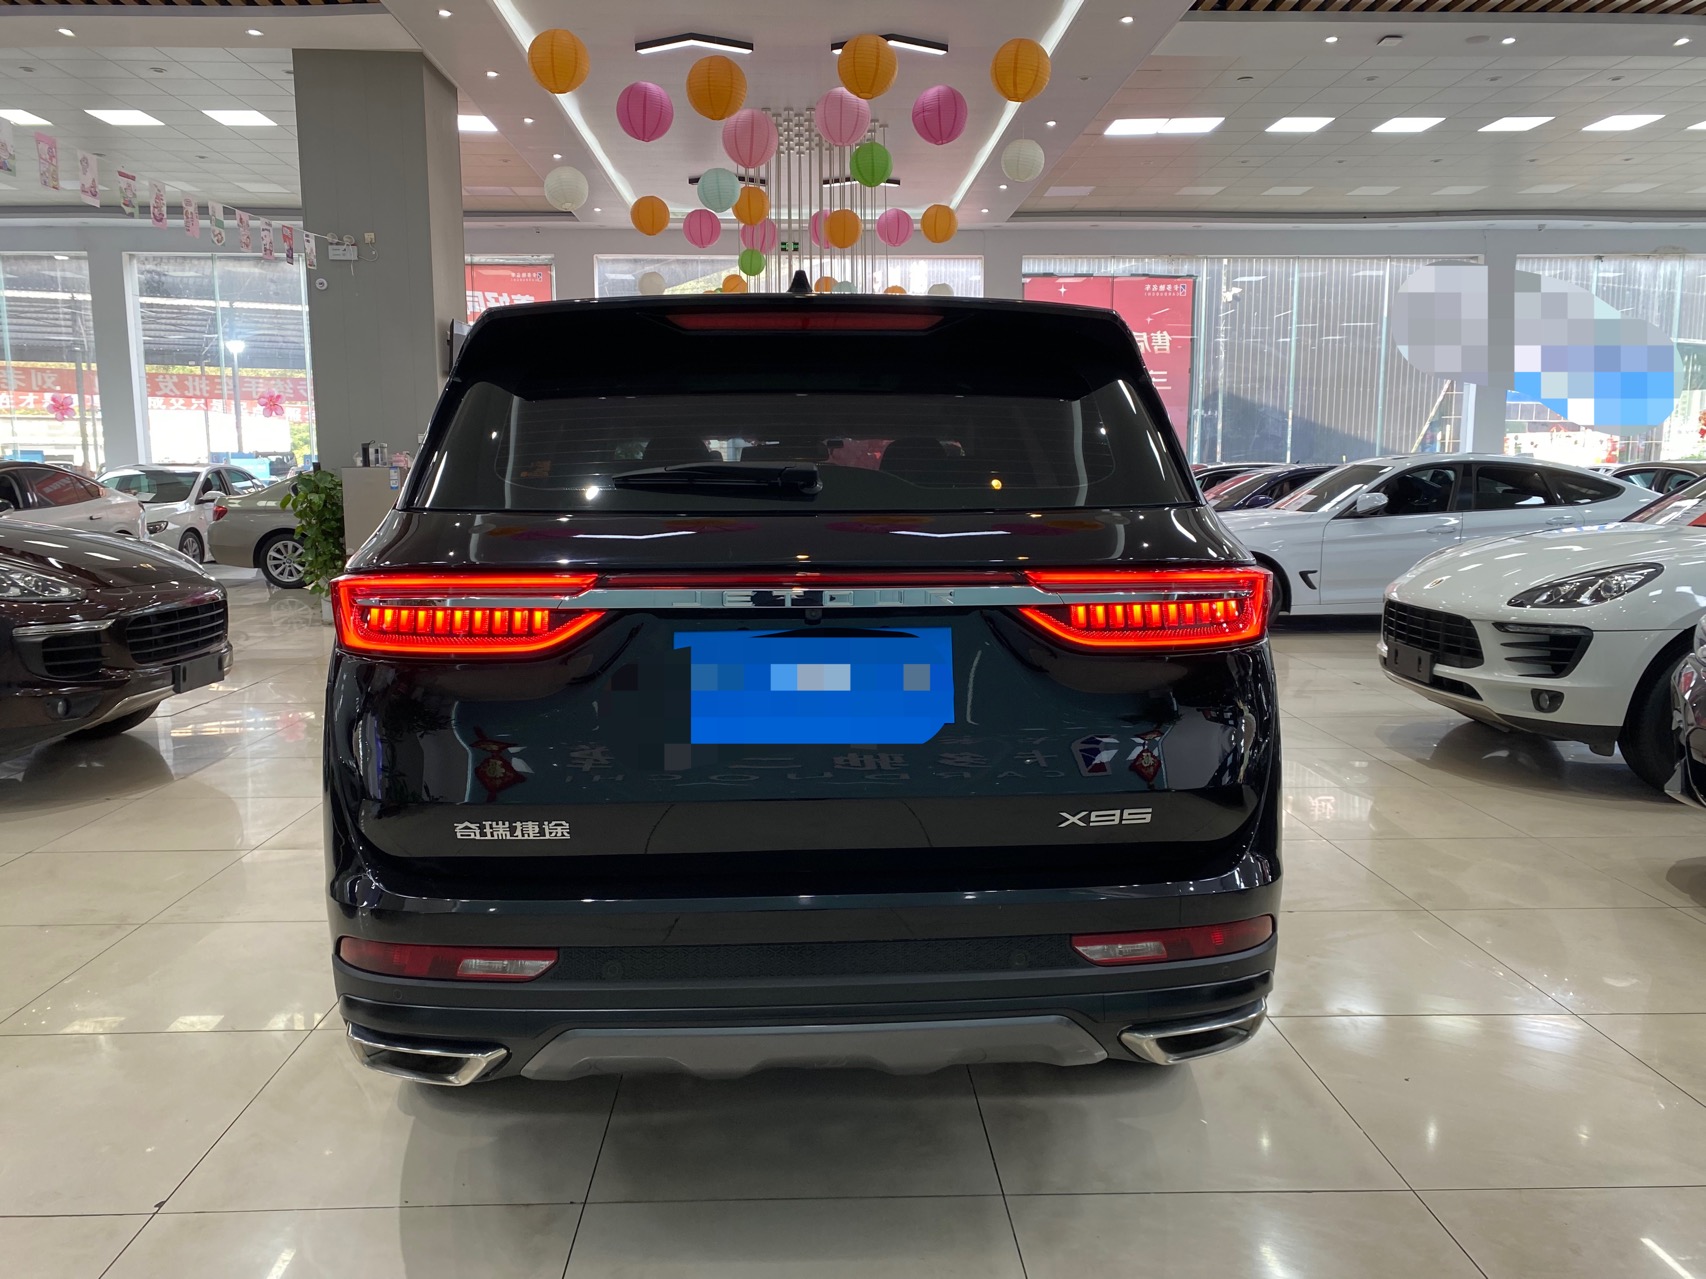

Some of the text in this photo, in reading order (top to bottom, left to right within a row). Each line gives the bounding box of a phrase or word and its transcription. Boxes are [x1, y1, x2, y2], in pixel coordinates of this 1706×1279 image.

[1057, 807, 1153, 828] X95
[453, 820, 571, 840] 奇瑞捷途
